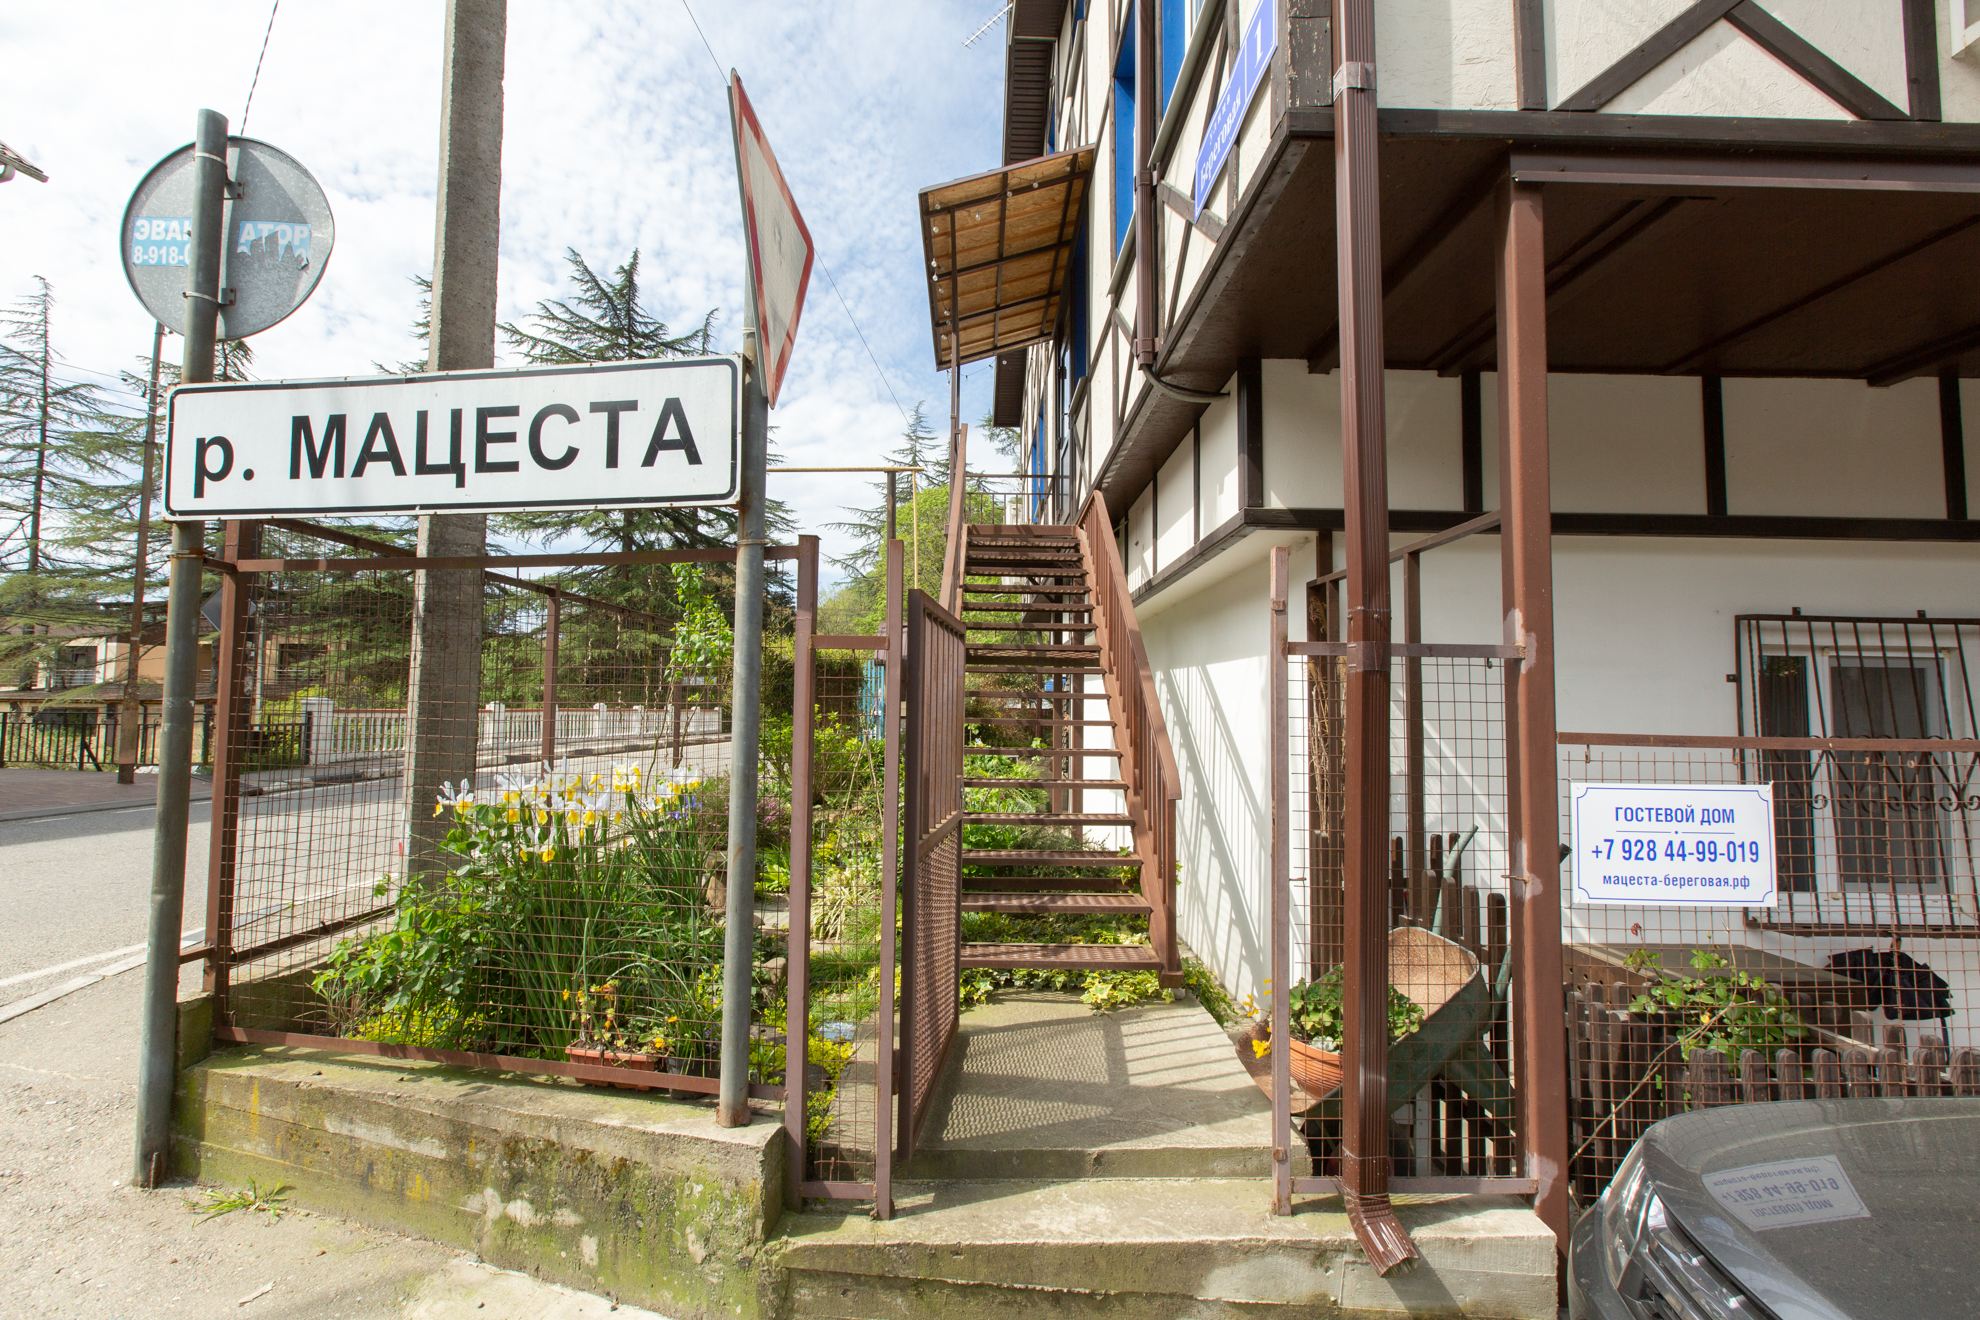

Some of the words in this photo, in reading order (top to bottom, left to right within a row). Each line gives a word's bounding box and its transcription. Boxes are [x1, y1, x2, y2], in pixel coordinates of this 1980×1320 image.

[1253, 18, 1264, 69] 1
[1200, 86, 1241, 192] Береговая
[193, 434, 255, 499] р.
[289, 397, 703, 489] МАЦЕСТА
[1614, 804, 1695, 823] ГОСТЕВОЙ
[1700, 808, 1735, 826] ДОМ
[1591, 838, 1615, 860] +7
[1621, 838, 1657, 861] 928
[1664, 840, 1759, 863] 44-99-019
[1602, 873, 1750, 890] мацеста-береговая.рф
